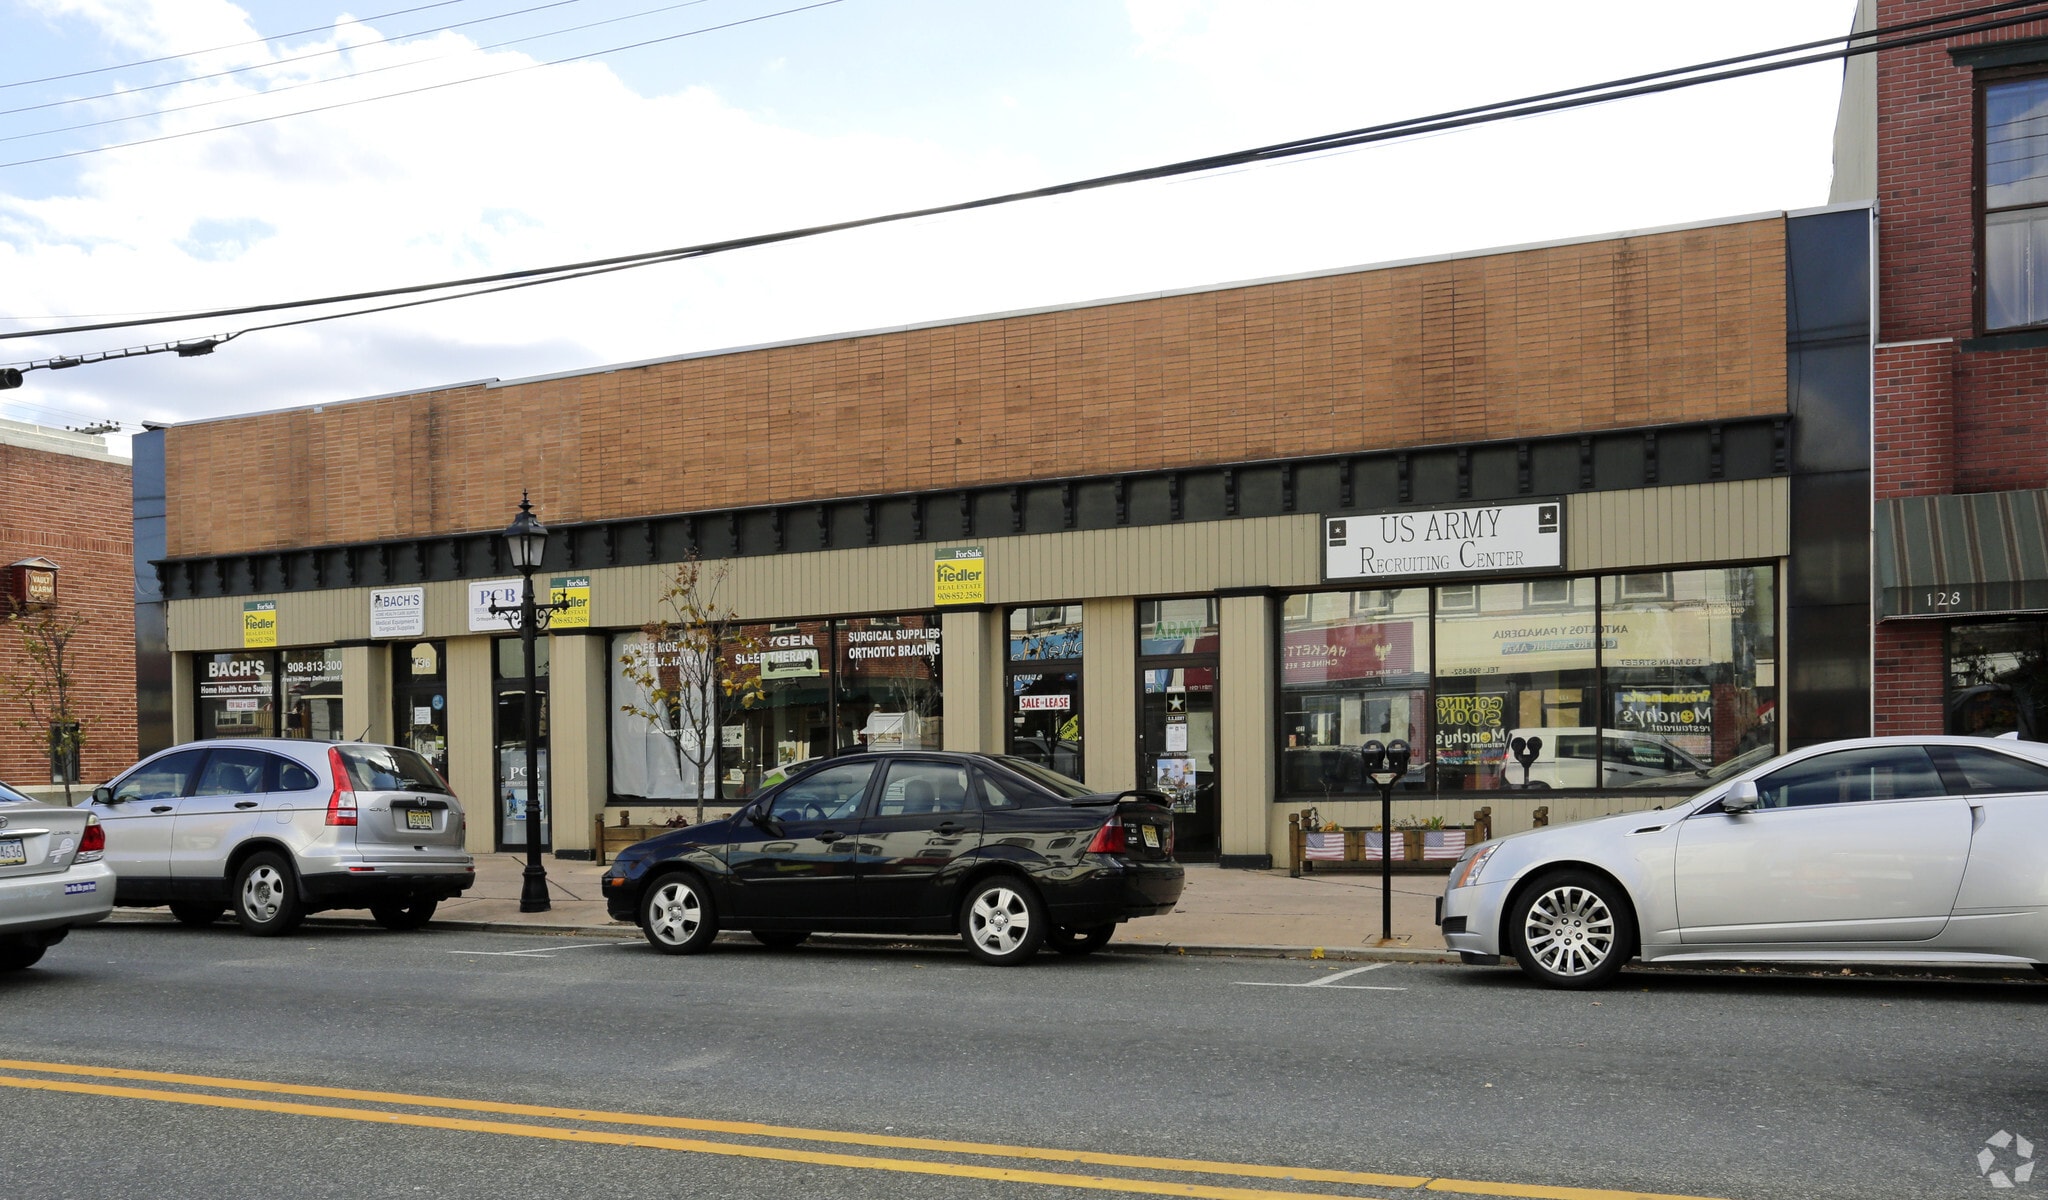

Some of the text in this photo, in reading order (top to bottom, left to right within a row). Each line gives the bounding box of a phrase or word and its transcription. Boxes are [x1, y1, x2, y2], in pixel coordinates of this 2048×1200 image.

[1380, 508, 1502, 544] US ARMY
[1459, 540, 1524, 568] CENTER
[937, 564, 982, 582] Fiedler
[30, 585, 52, 593] ALARM
[480, 588, 515, 606] PCB
[383, 594, 420, 607] BACH'S
[552, 592, 588, 608] Fidler
[1927, 591, 1960, 606] 128
[245, 615, 275, 629] Fiedler
[1153, 619, 1203, 641] ARMY
[848, 627, 940, 642] SURGICAL SUPPLIES
[623, 643, 655, 654] POWER
[848, 643, 940, 659] ORTHOTIC BRACING
[735, 649, 817, 665] SLEEP THERAPY
[208, 660, 265, 677] BACH'S
[201, 683, 273, 694] Home Health Care Supply
[1021, 698, 1040, 708] SALE
[1045, 697, 1069, 708] LEASE
